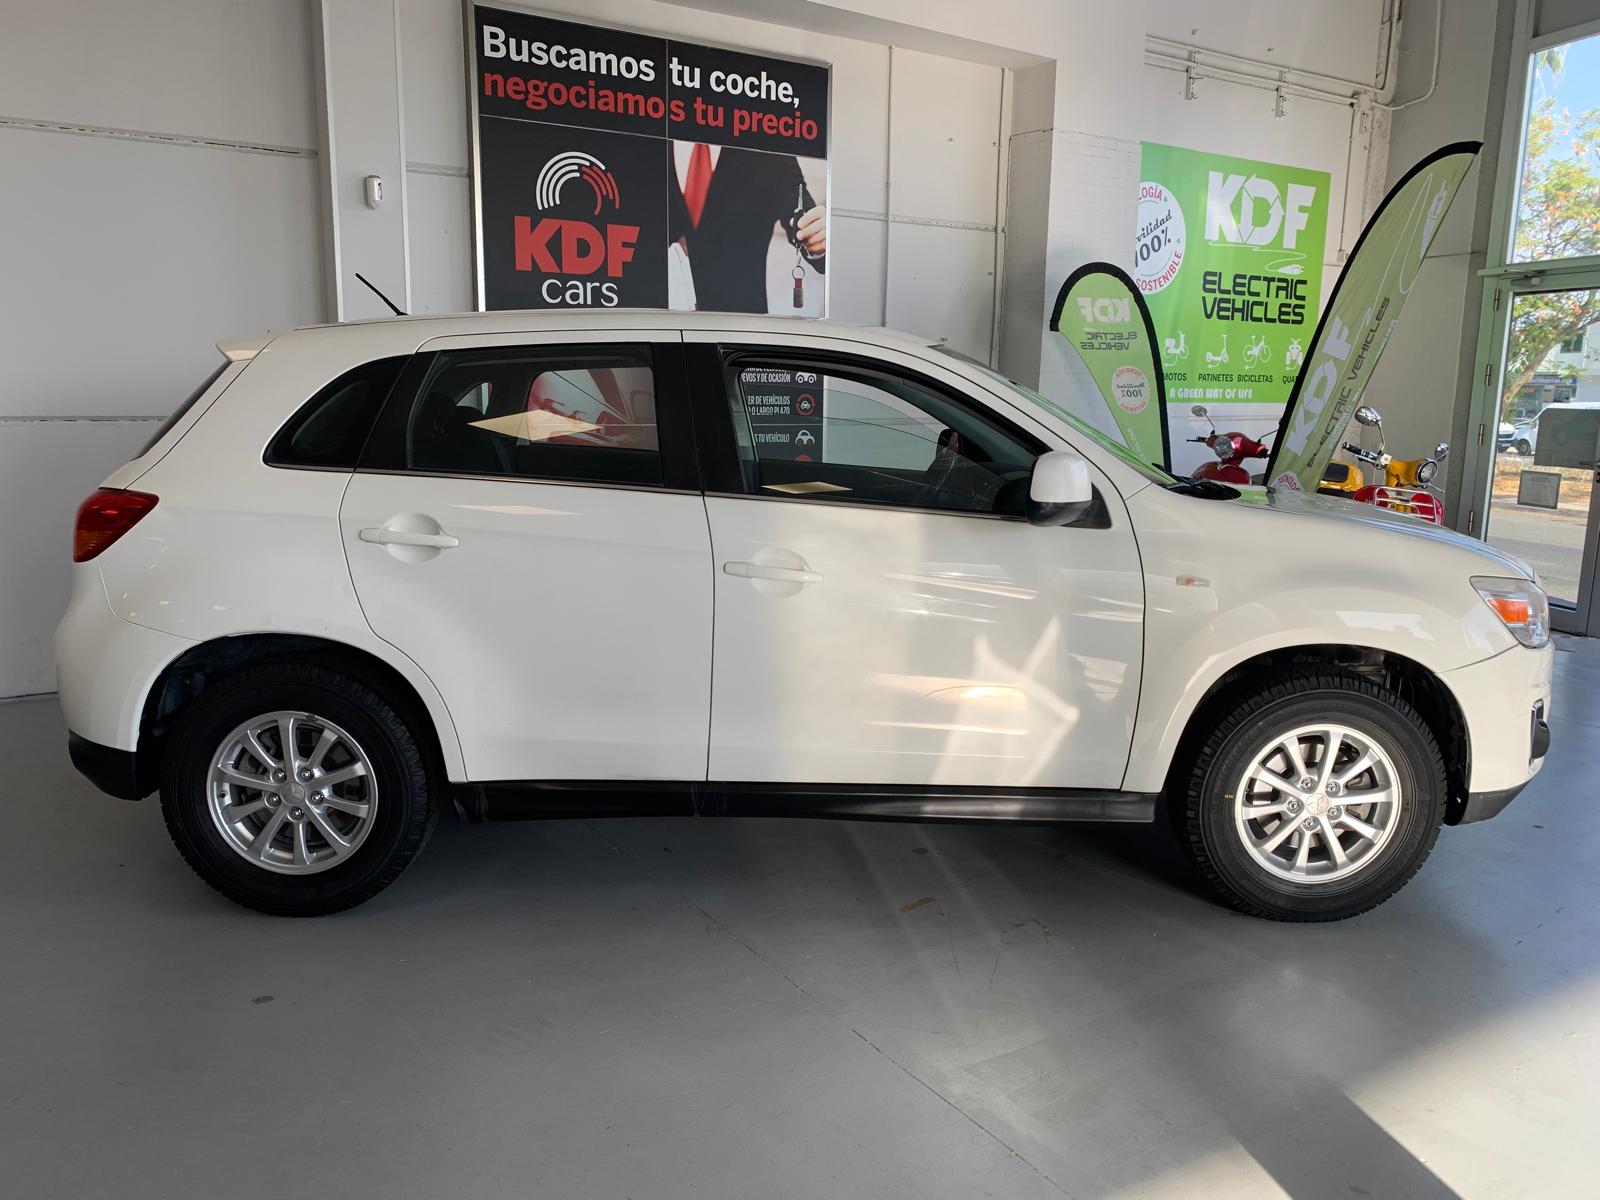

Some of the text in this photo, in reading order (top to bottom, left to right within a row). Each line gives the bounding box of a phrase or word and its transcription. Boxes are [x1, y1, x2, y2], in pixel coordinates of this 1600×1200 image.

[482, 25, 800, 108] Buscamos tu coche,
[483, 71, 818, 140] negociamos tu precio
[1204, 170, 1316, 249] KDF
[514, 215, 641, 278] KDF
[541, 279, 619, 307] cars
[1203, 271, 1308, 301] ELECTRIC
[1202, 296, 1306, 325] VEHICLES
[1347, 296, 1391, 382] VEHICLES
[761, 373, 768, 382] DE
[768, 371, 791, 382] OCASIÓN
[1198, 374, 1234, 383] PATINETES
[1237, 374, 1274, 383] BICICLETAS
[1286, 315, 1351, 456] KDF
[755, 395, 763, 405] DE
[763, 393, 791, 405] VEHÍCULOS
[1205, 387, 1224, 399] WAY
[1225, 387, 1236, 399] OF
[766, 432, 790, 443] VEHÍCULO
